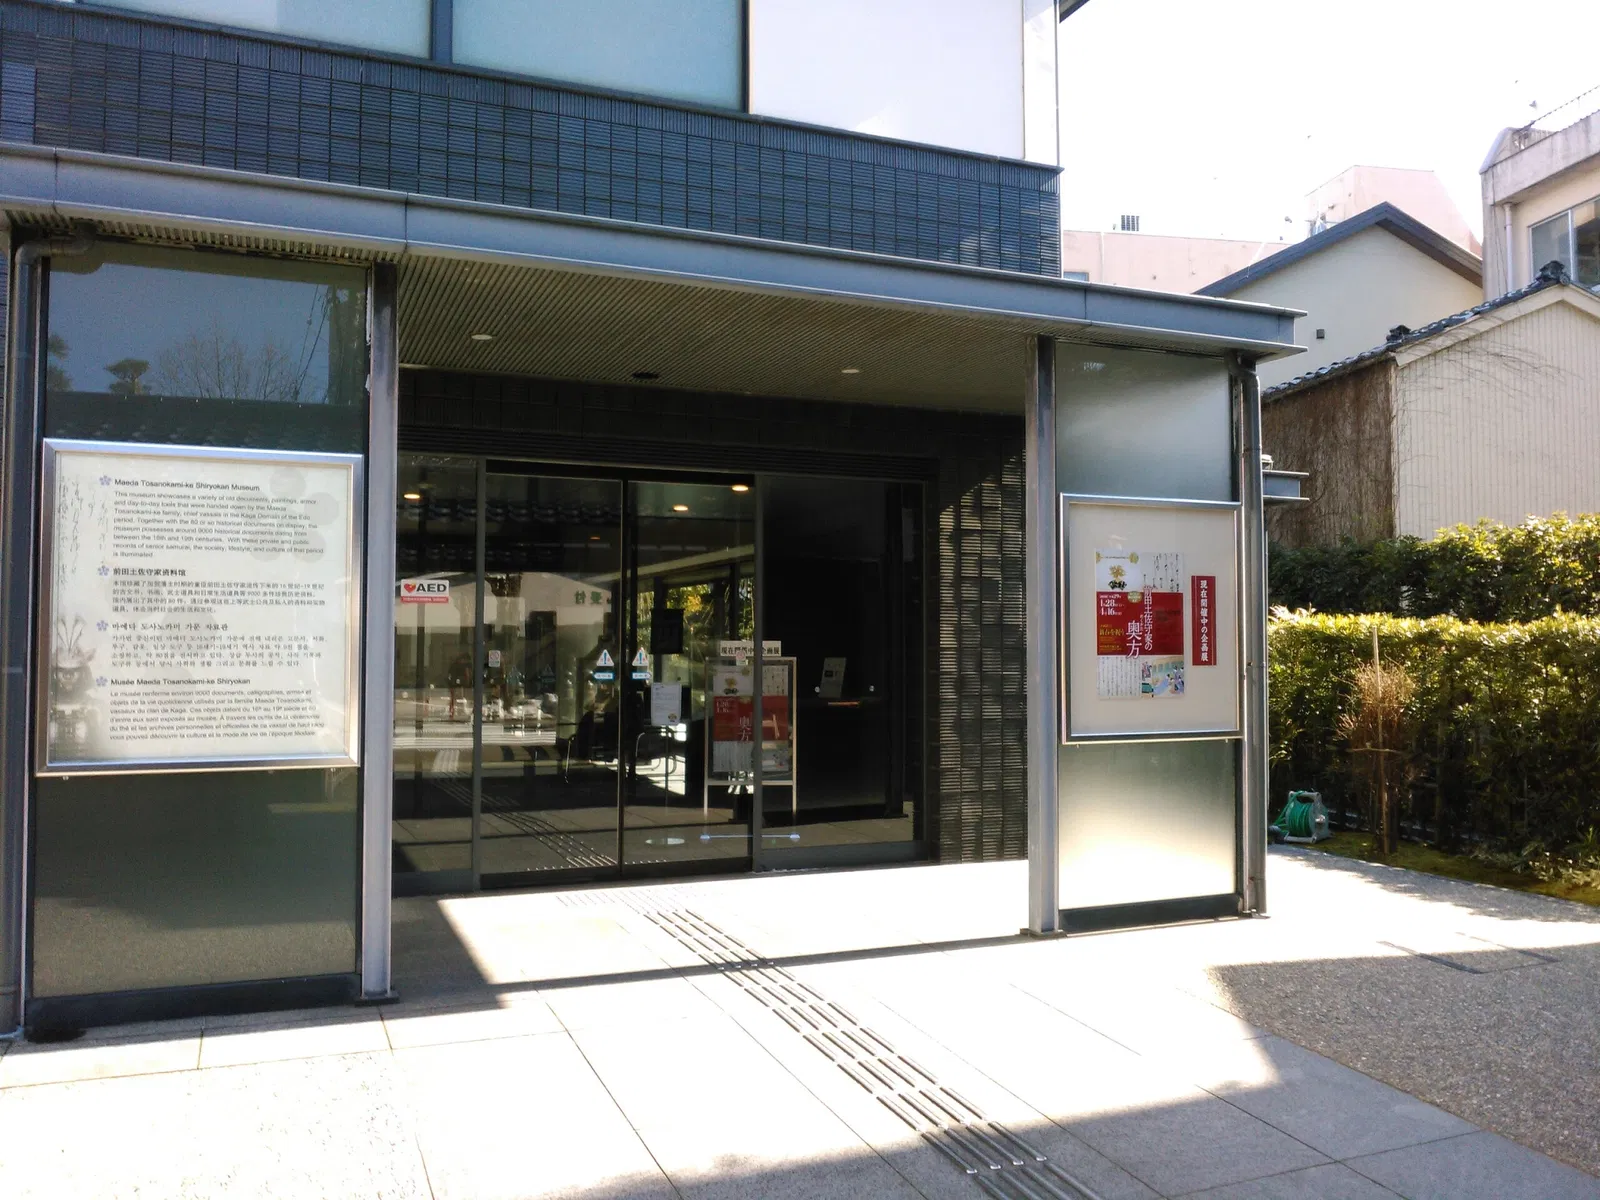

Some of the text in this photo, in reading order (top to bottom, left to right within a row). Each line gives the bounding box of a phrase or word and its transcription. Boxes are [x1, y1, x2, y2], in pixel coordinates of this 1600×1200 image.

[416, 583, 447, 593] AED
[1143, 585, 1153, 651] 前田土佐守家の
[1126, 620, 1143, 659] 奥方
